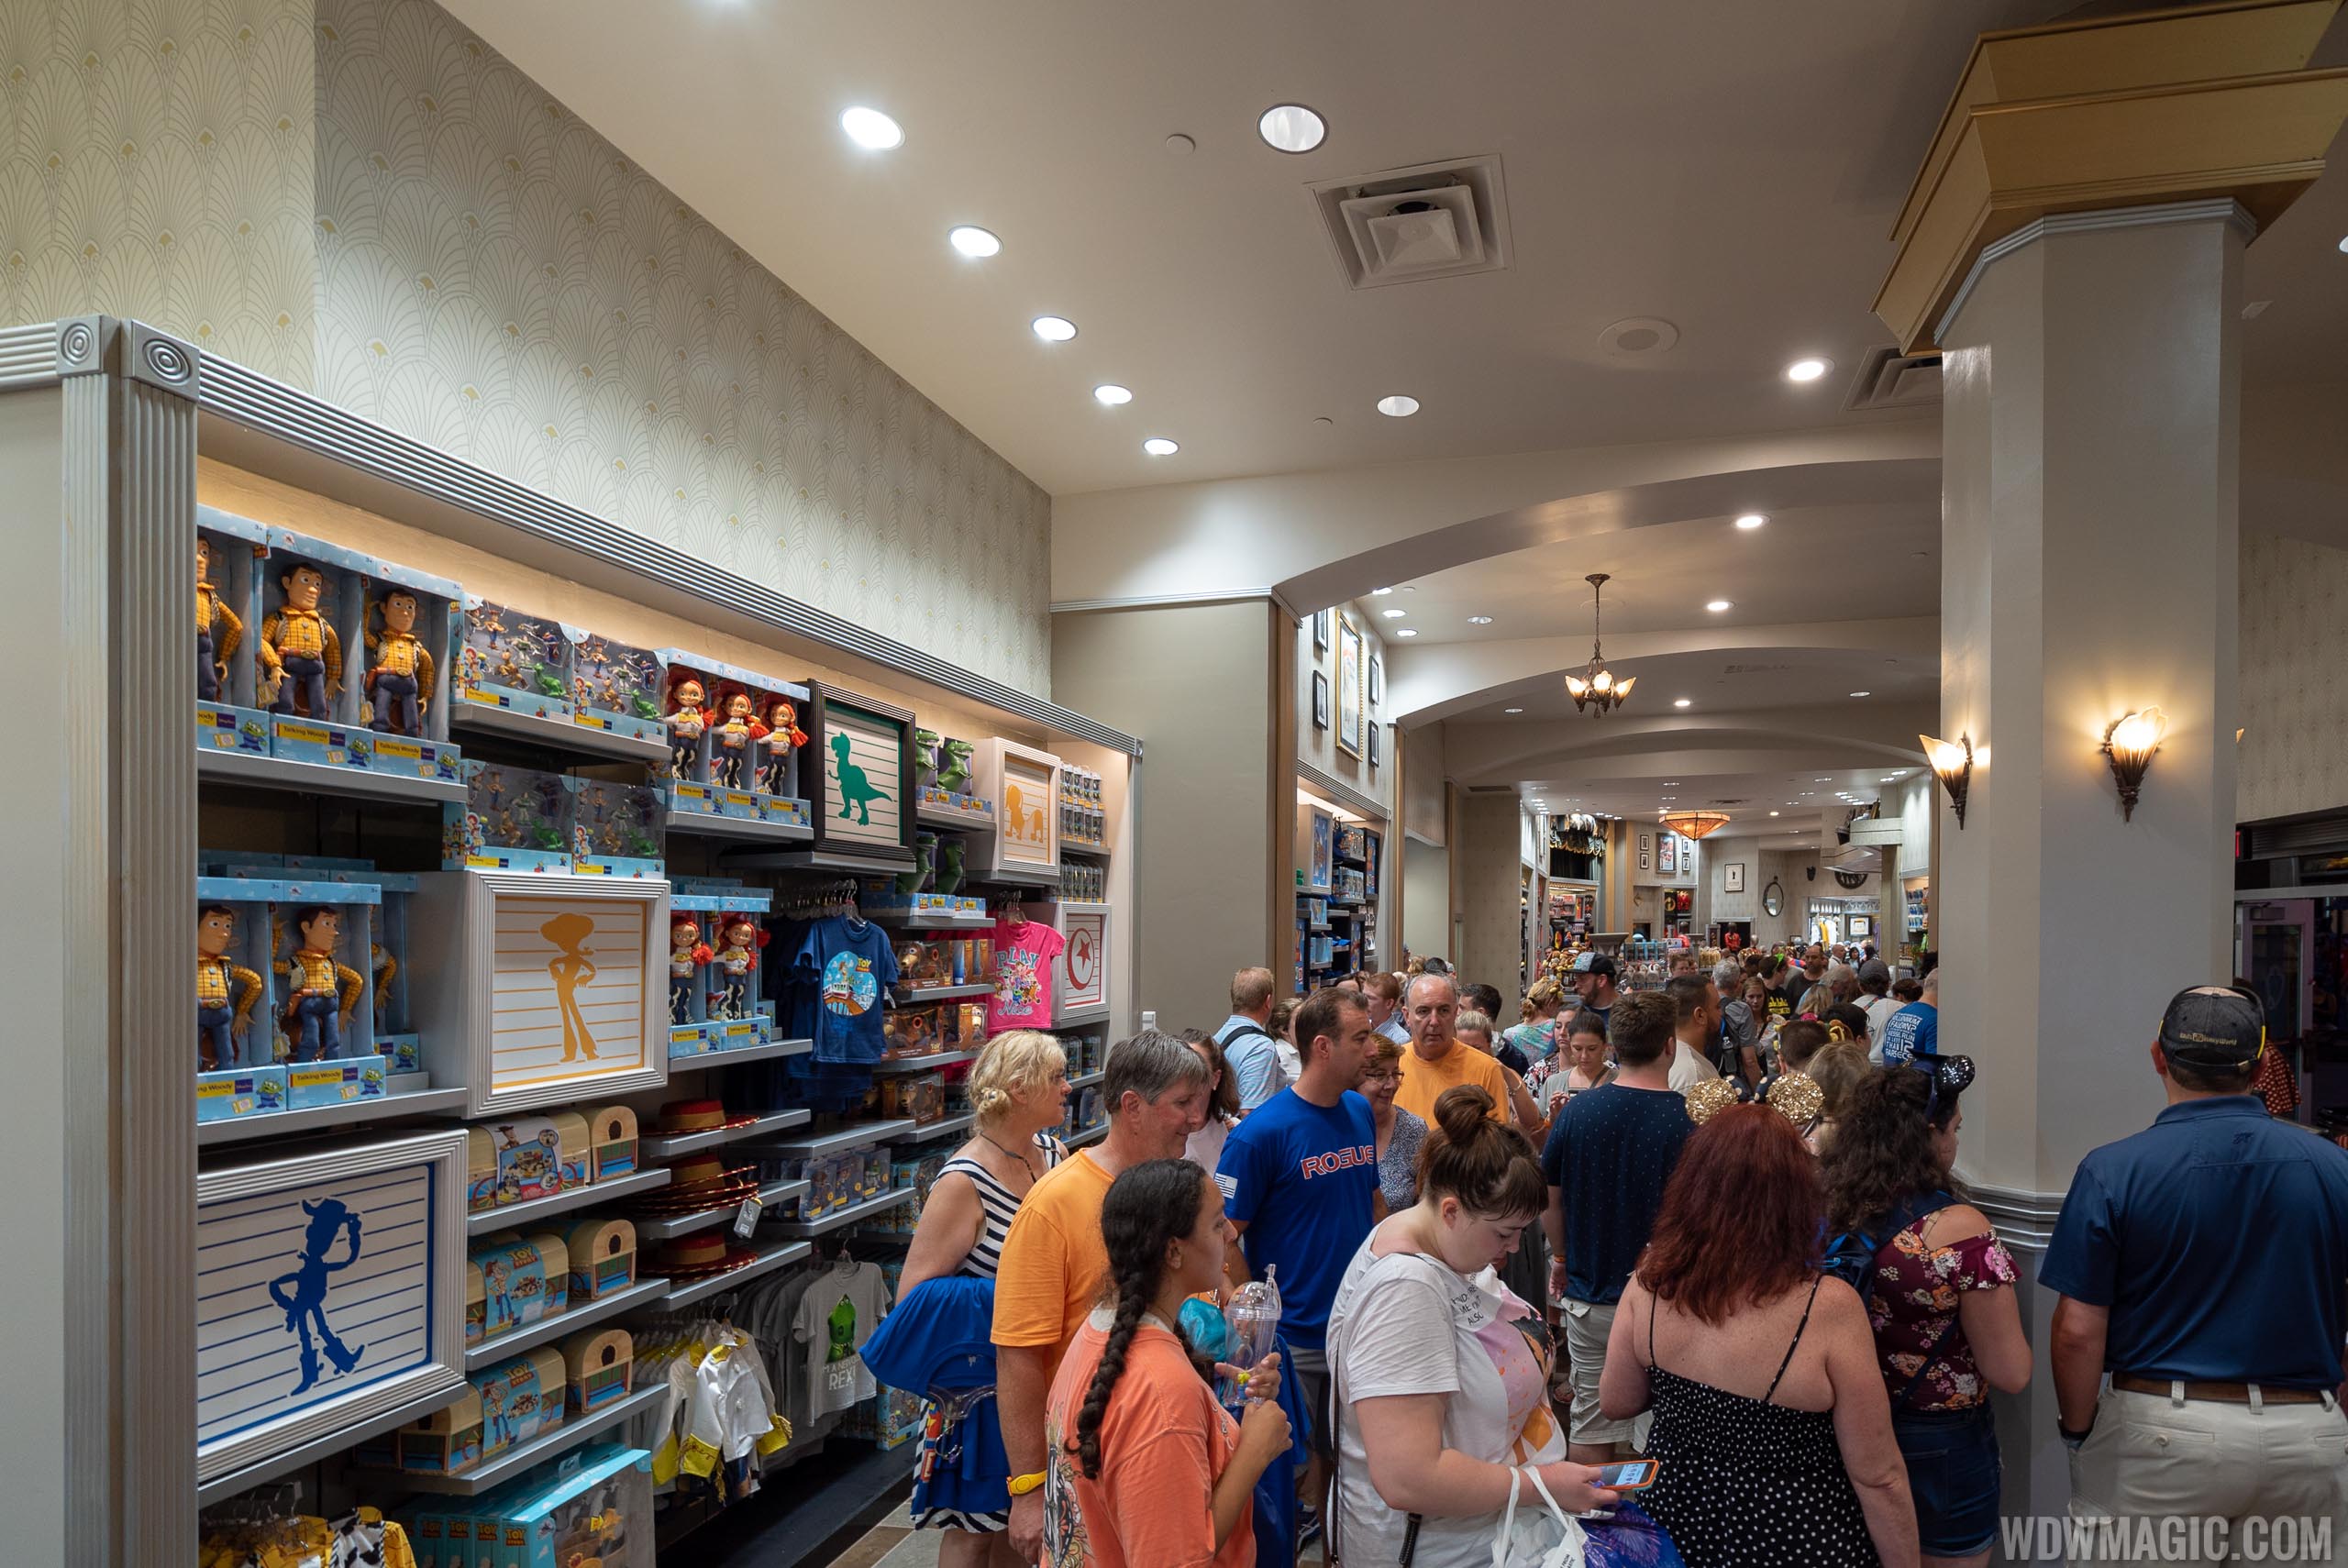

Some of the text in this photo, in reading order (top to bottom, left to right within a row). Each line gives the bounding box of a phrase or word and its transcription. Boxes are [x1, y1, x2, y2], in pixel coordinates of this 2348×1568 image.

[283, 725, 306, 736] Talking
[306, 729, 328, 739] Woody
[379, 742, 420, 754] Talking Woody
[858, 957, 872, 968] TOY
[996, 947, 1040, 969] PLAY
[998, 1000, 1033, 1016] Nice
[1901, 1032, 1915, 1043] RUN
[1900, 1039, 1914, 1053] 12
[296, 1073, 319, 1082] Talking
[320, 1071, 341, 1079] Woody
[208, 1083, 233, 1092] Woody
[1301, 1145, 1374, 1180] ROGUE
[506, 1246, 534, 1260] TOY
[504, 1362, 529, 1379] TOY
[449, 1520, 470, 1532] TOY
[478, 1523, 498, 1534] TOY
[505, 1529, 526, 1540] TOY
